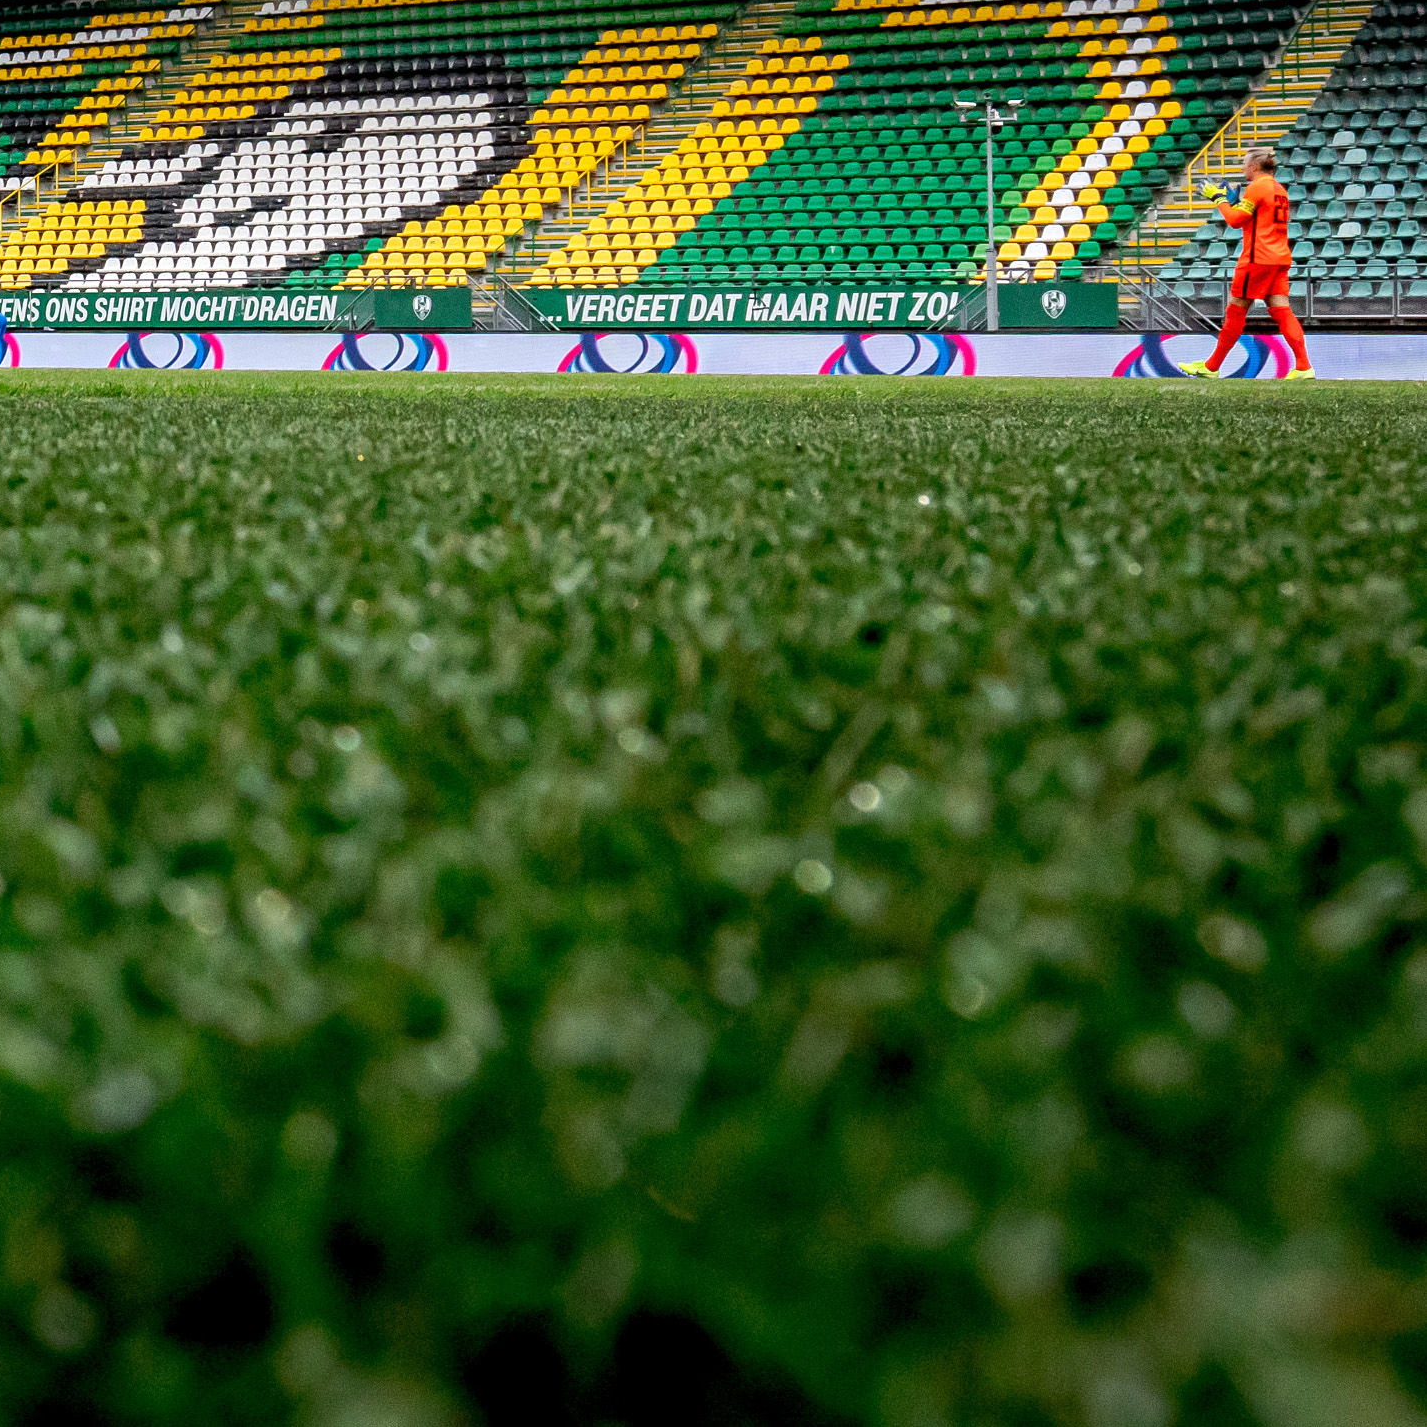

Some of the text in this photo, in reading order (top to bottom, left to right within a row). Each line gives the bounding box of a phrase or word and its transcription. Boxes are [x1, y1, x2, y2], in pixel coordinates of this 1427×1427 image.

[45, 298, 88, 322] ONS
[94, 296, 158, 322] SHIRT
[160, 296, 238, 322] MOCHT
[688, 293, 743, 321] DAT
[745, 293, 829, 321] MAAR
[835, 292, 904, 321] NIET
[908, 291, 959, 321] ZO!
